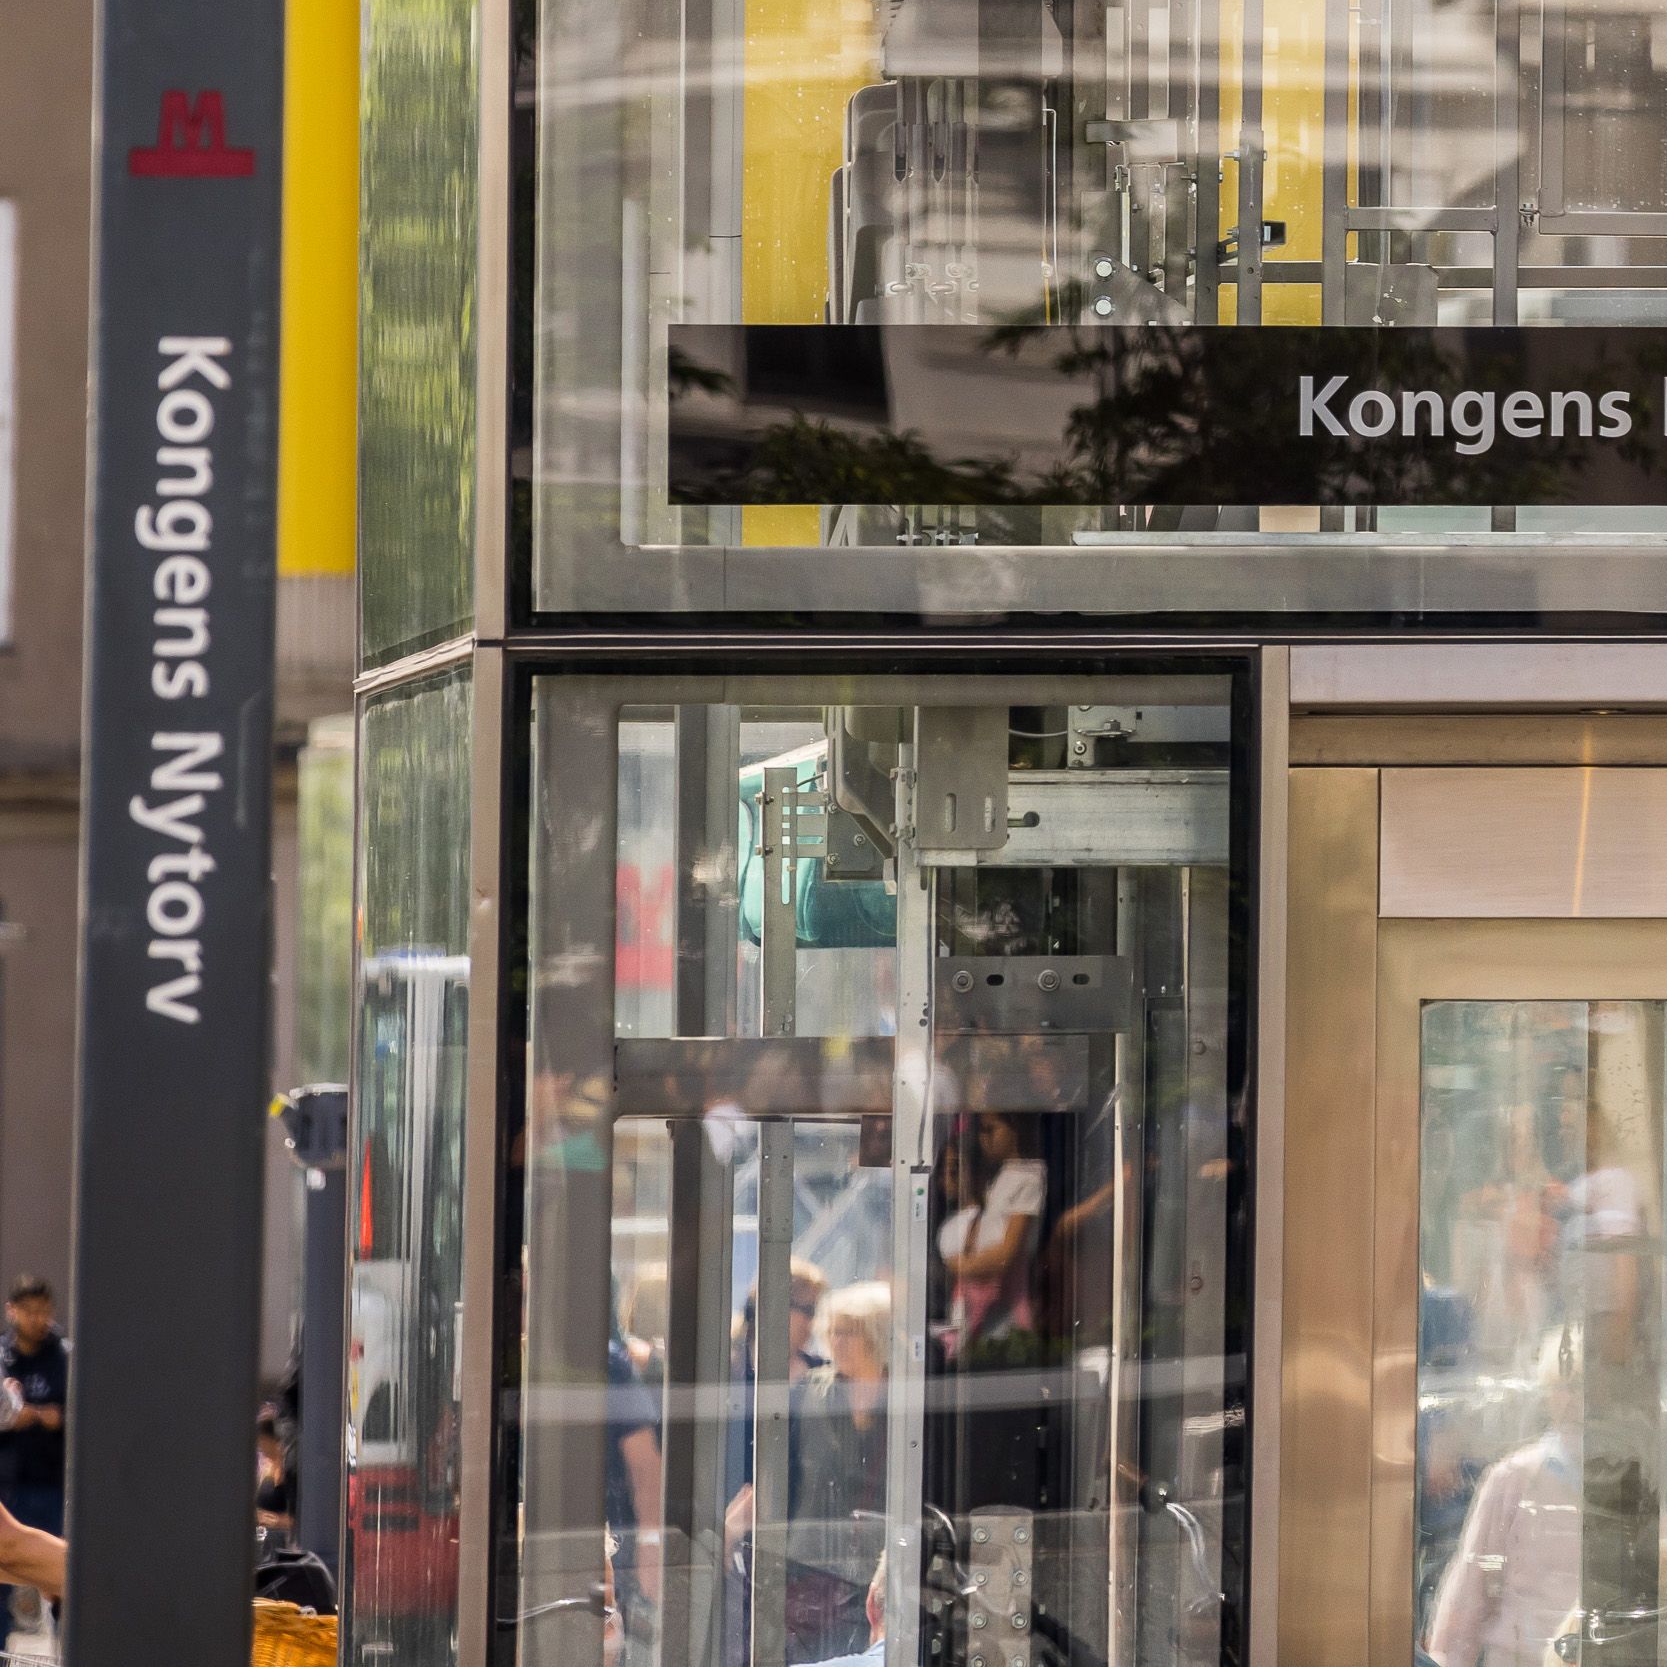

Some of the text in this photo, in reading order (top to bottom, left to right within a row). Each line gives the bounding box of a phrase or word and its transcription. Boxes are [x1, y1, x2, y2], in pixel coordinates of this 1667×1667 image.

[1299, 375, 1632, 455] Kongens
[129, 335, 232, 1025] Kongens Nytorv
